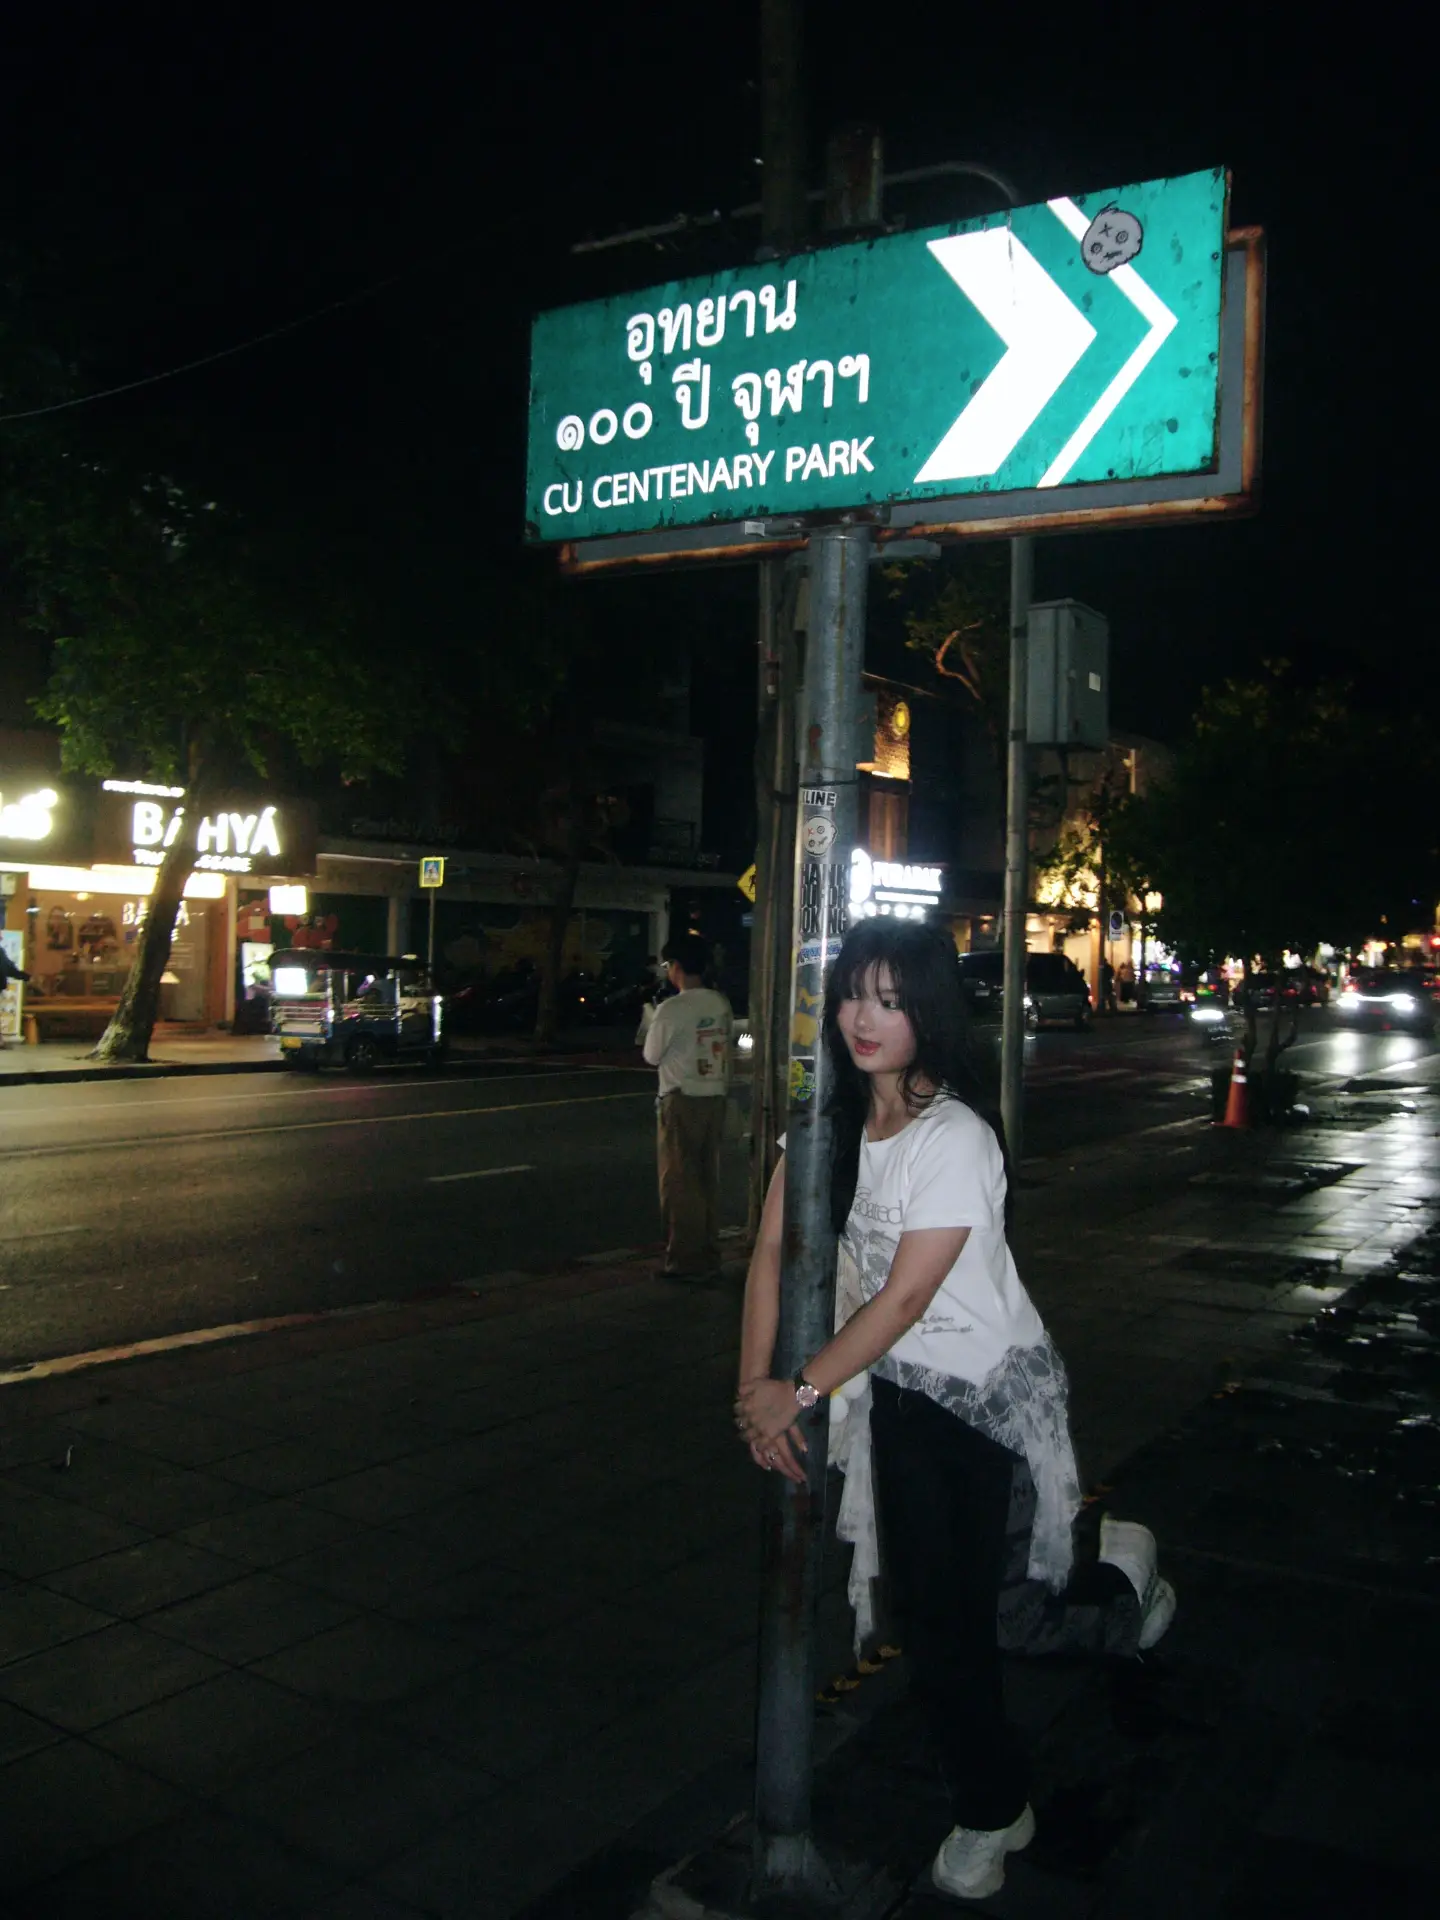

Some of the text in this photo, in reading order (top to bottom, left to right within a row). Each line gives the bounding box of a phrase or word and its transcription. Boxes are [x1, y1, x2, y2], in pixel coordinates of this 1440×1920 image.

[626, 279, 797, 386] อุทยาน
[556, 353, 870, 451] ๑๐๐ ปี จุฬาฯ
[543, 436, 875, 516] CU CENTENARY PARK
